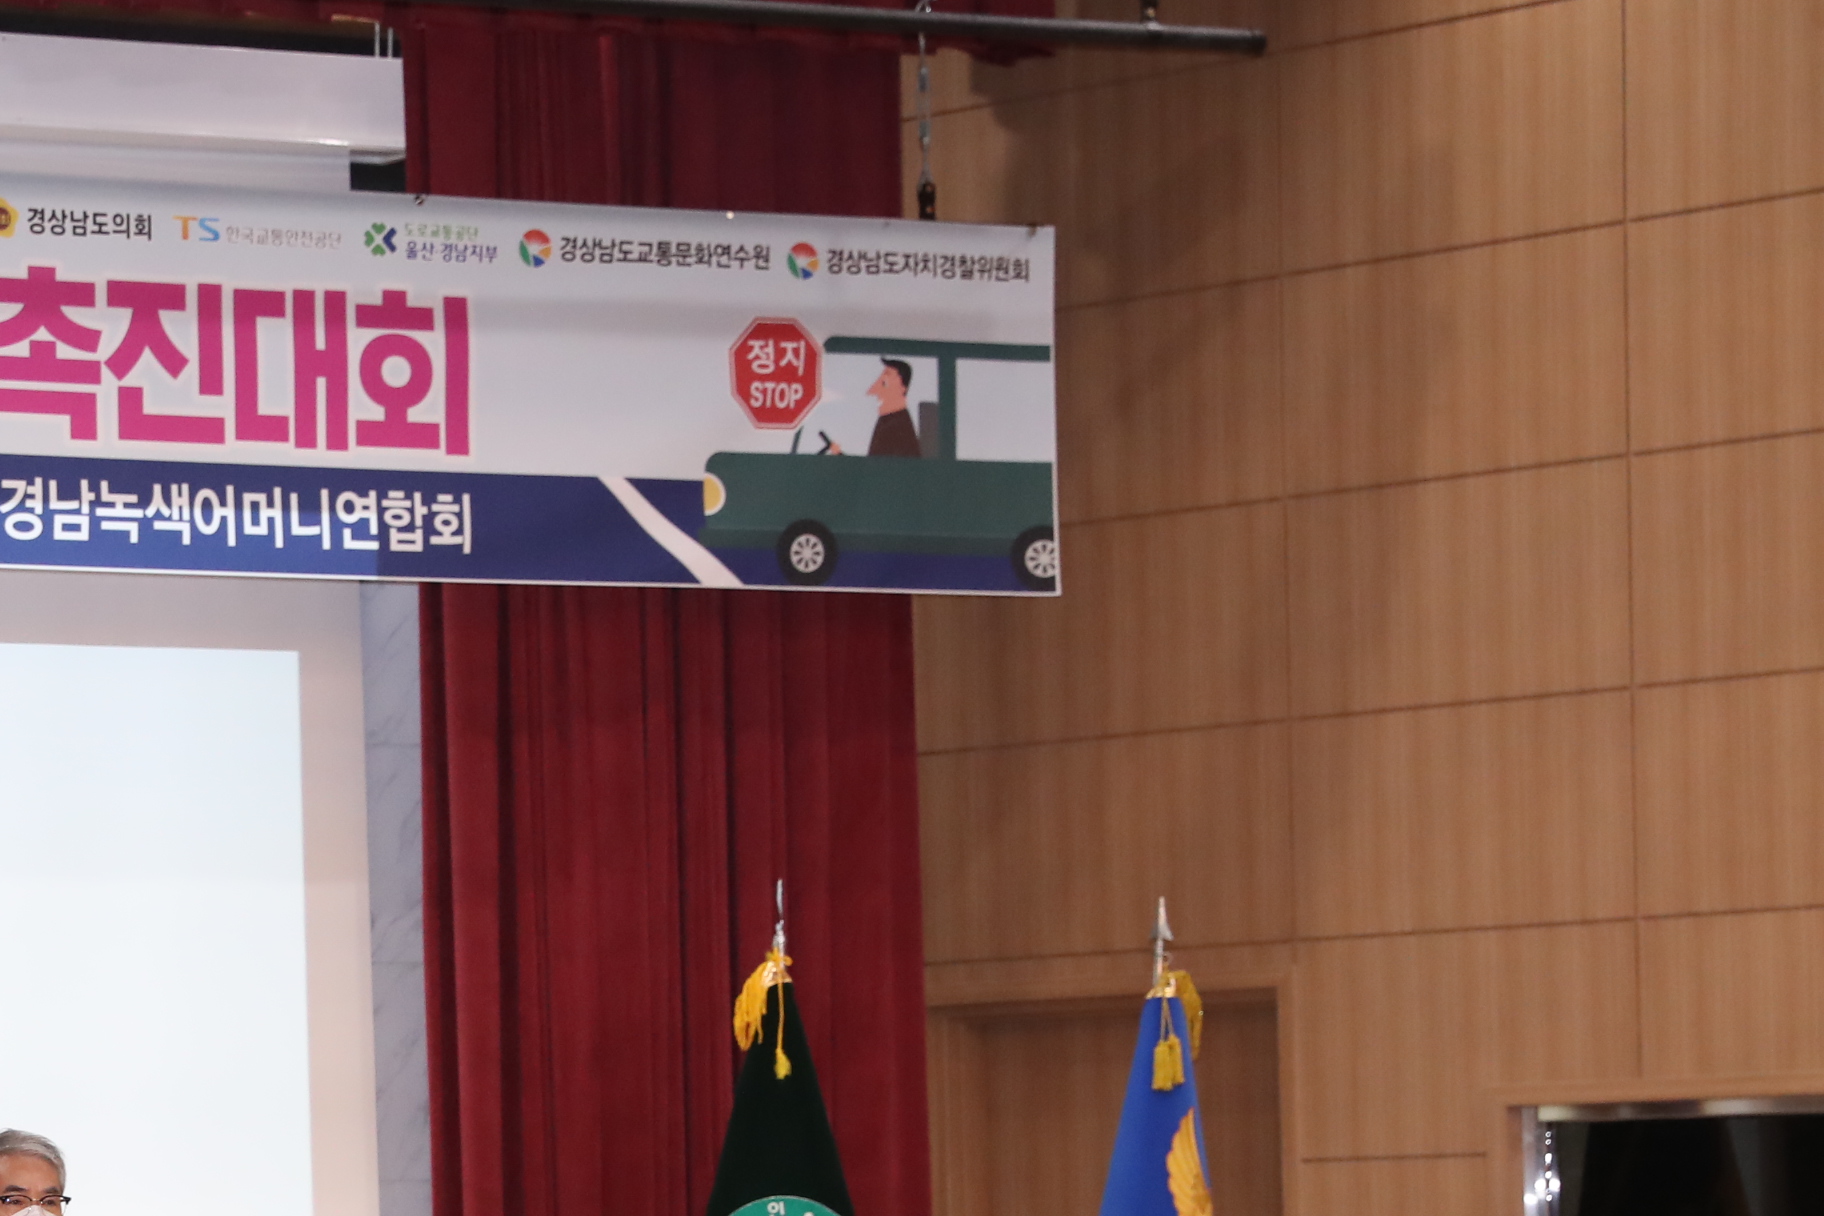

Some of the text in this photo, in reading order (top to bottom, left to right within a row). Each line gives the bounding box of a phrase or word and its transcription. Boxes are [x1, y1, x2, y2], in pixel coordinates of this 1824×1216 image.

[26, 206, 153, 241] 경상남도의회
[172, 215, 221, 243] TS
[225, 225, 342, 250] 한국교통안전공단
[559, 236, 771, 271] 경상남도교통문화연수원
[826, 247, 1031, 283] 경상남도자치경찰위원회
[747, 337, 806, 376] 정지
[749, 381, 804, 410] STOP
